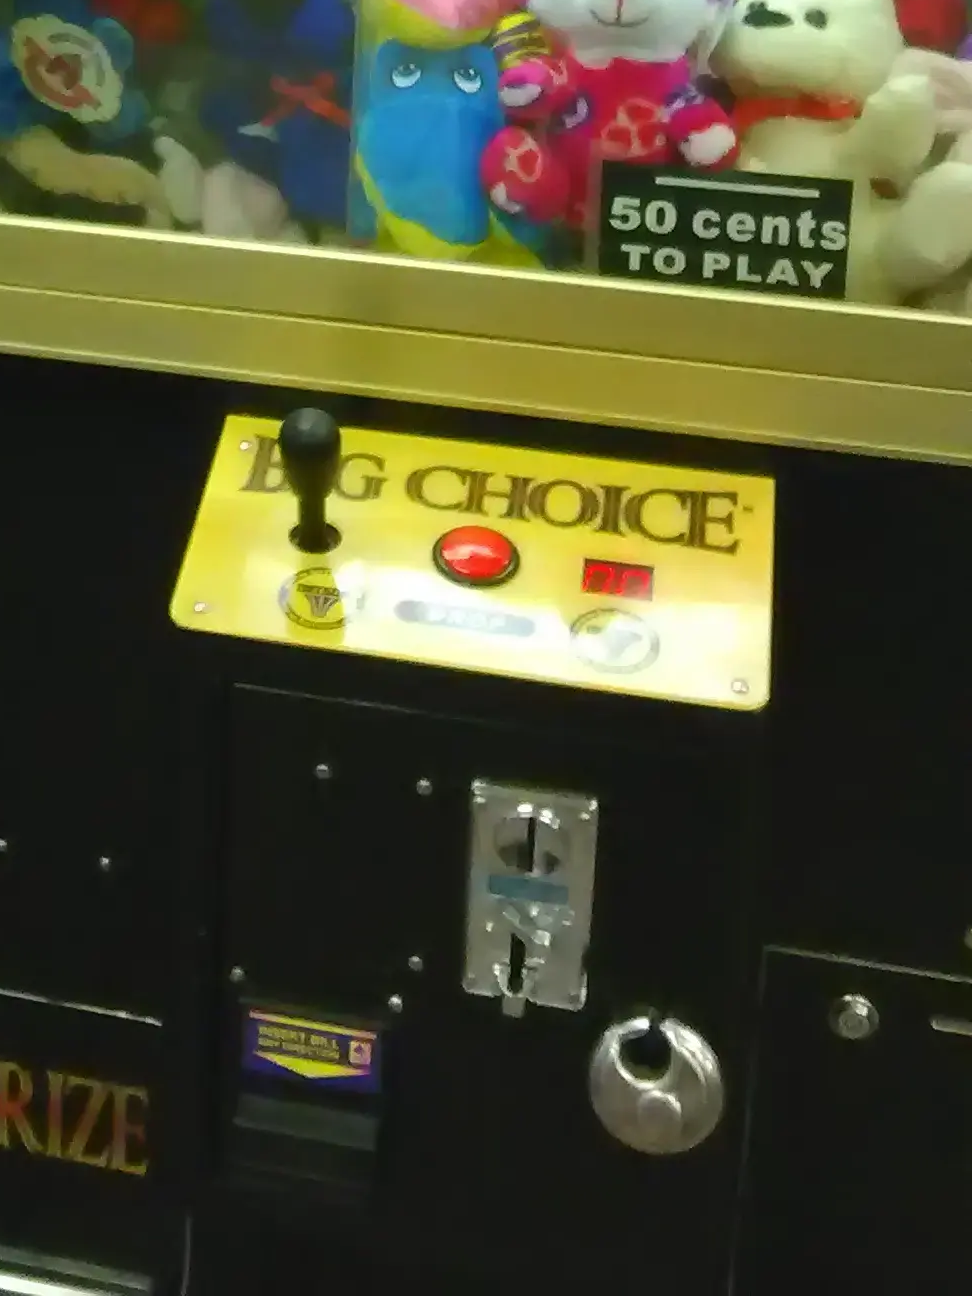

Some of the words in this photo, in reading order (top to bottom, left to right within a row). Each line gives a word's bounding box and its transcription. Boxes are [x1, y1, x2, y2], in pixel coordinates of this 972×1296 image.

[608, 195, 678, 235] 50
[691, 208, 847, 251] cents
[620, 242, 686, 275] TO
[702, 249, 834, 289] PLAY
[237, 433, 389, 502] BG
[404, 463, 743, 556] CHOICE
